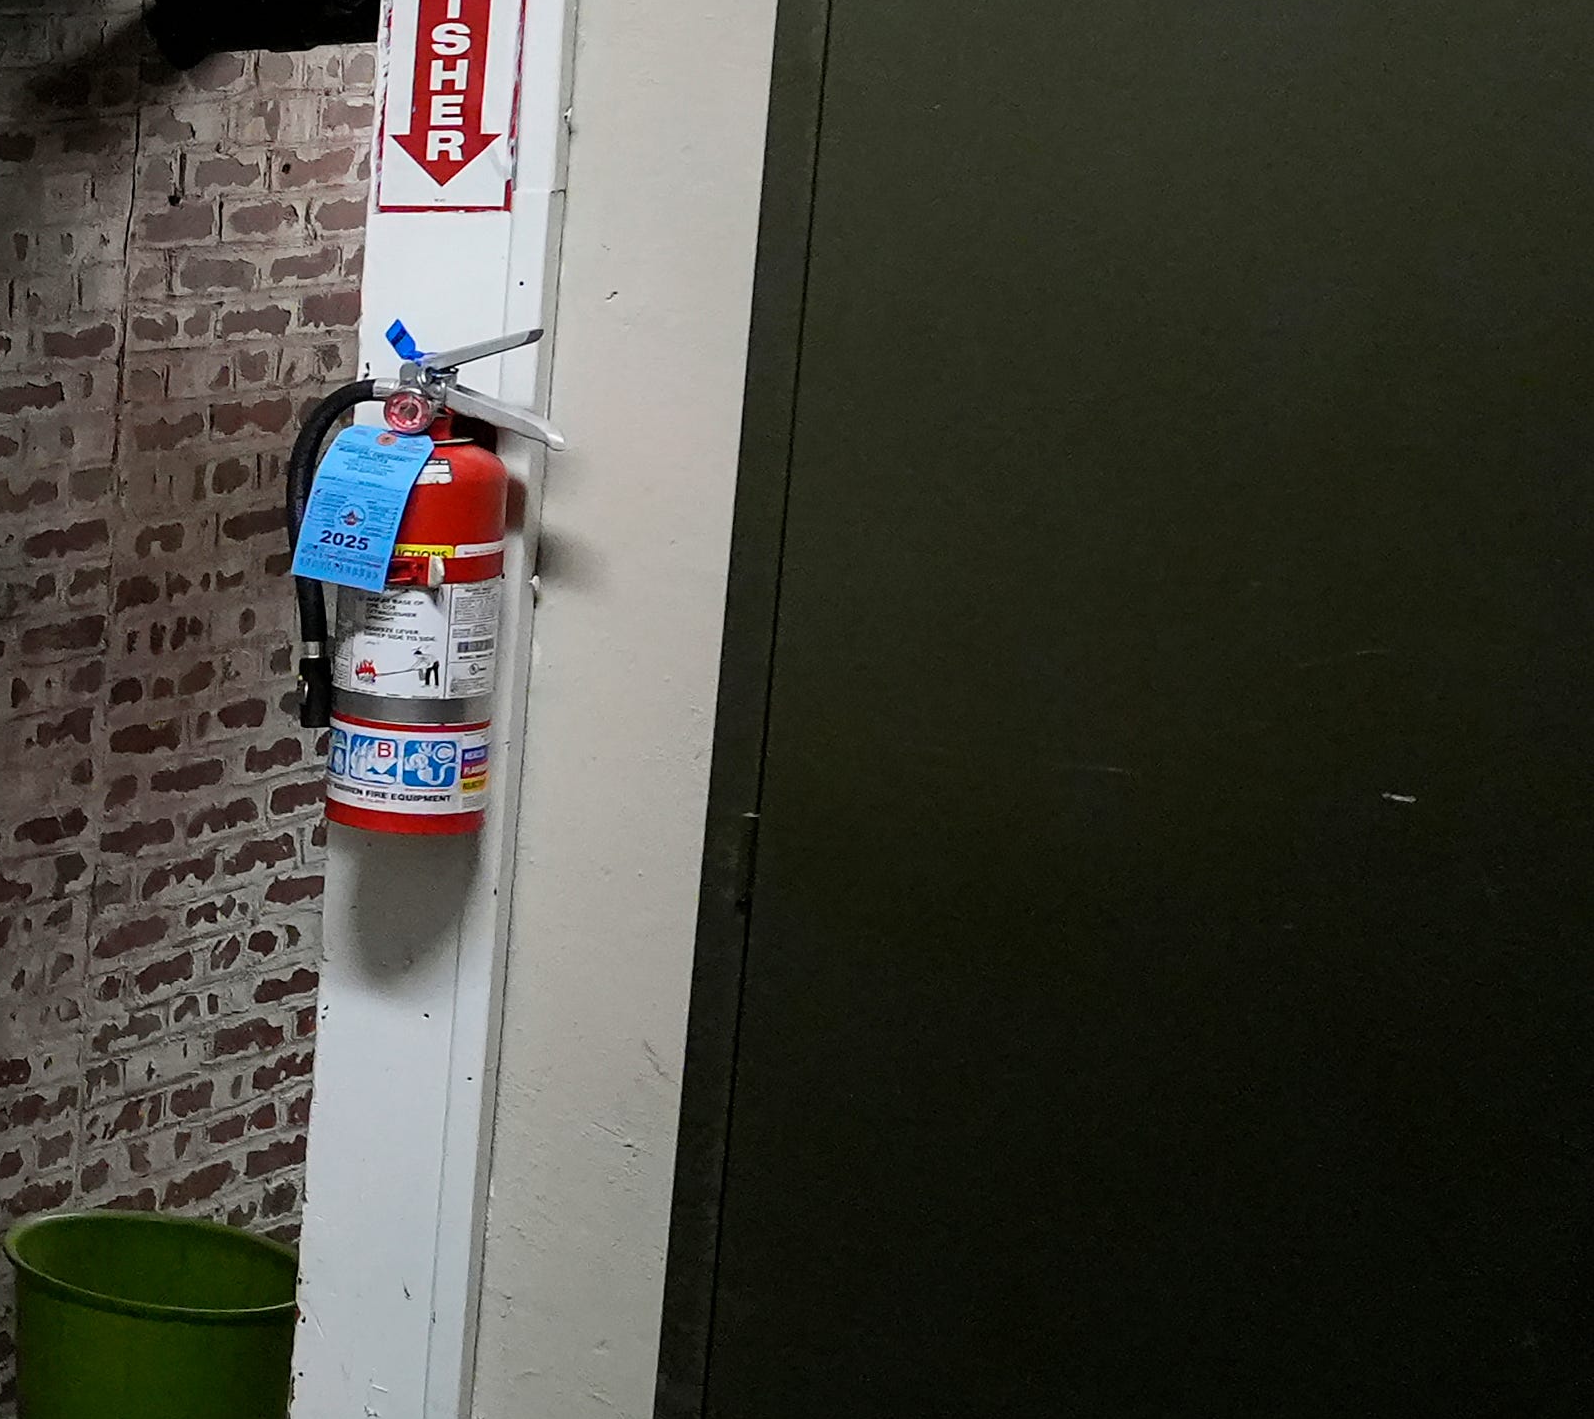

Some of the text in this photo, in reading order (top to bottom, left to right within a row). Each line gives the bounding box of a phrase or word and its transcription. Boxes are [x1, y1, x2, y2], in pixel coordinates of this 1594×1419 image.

[320, 529, 370, 552] 2025
[377, 741, 392, 758] B
[365, 790, 389, 799] FIRE
[391, 793, 452, 803] EQUIPMENT
